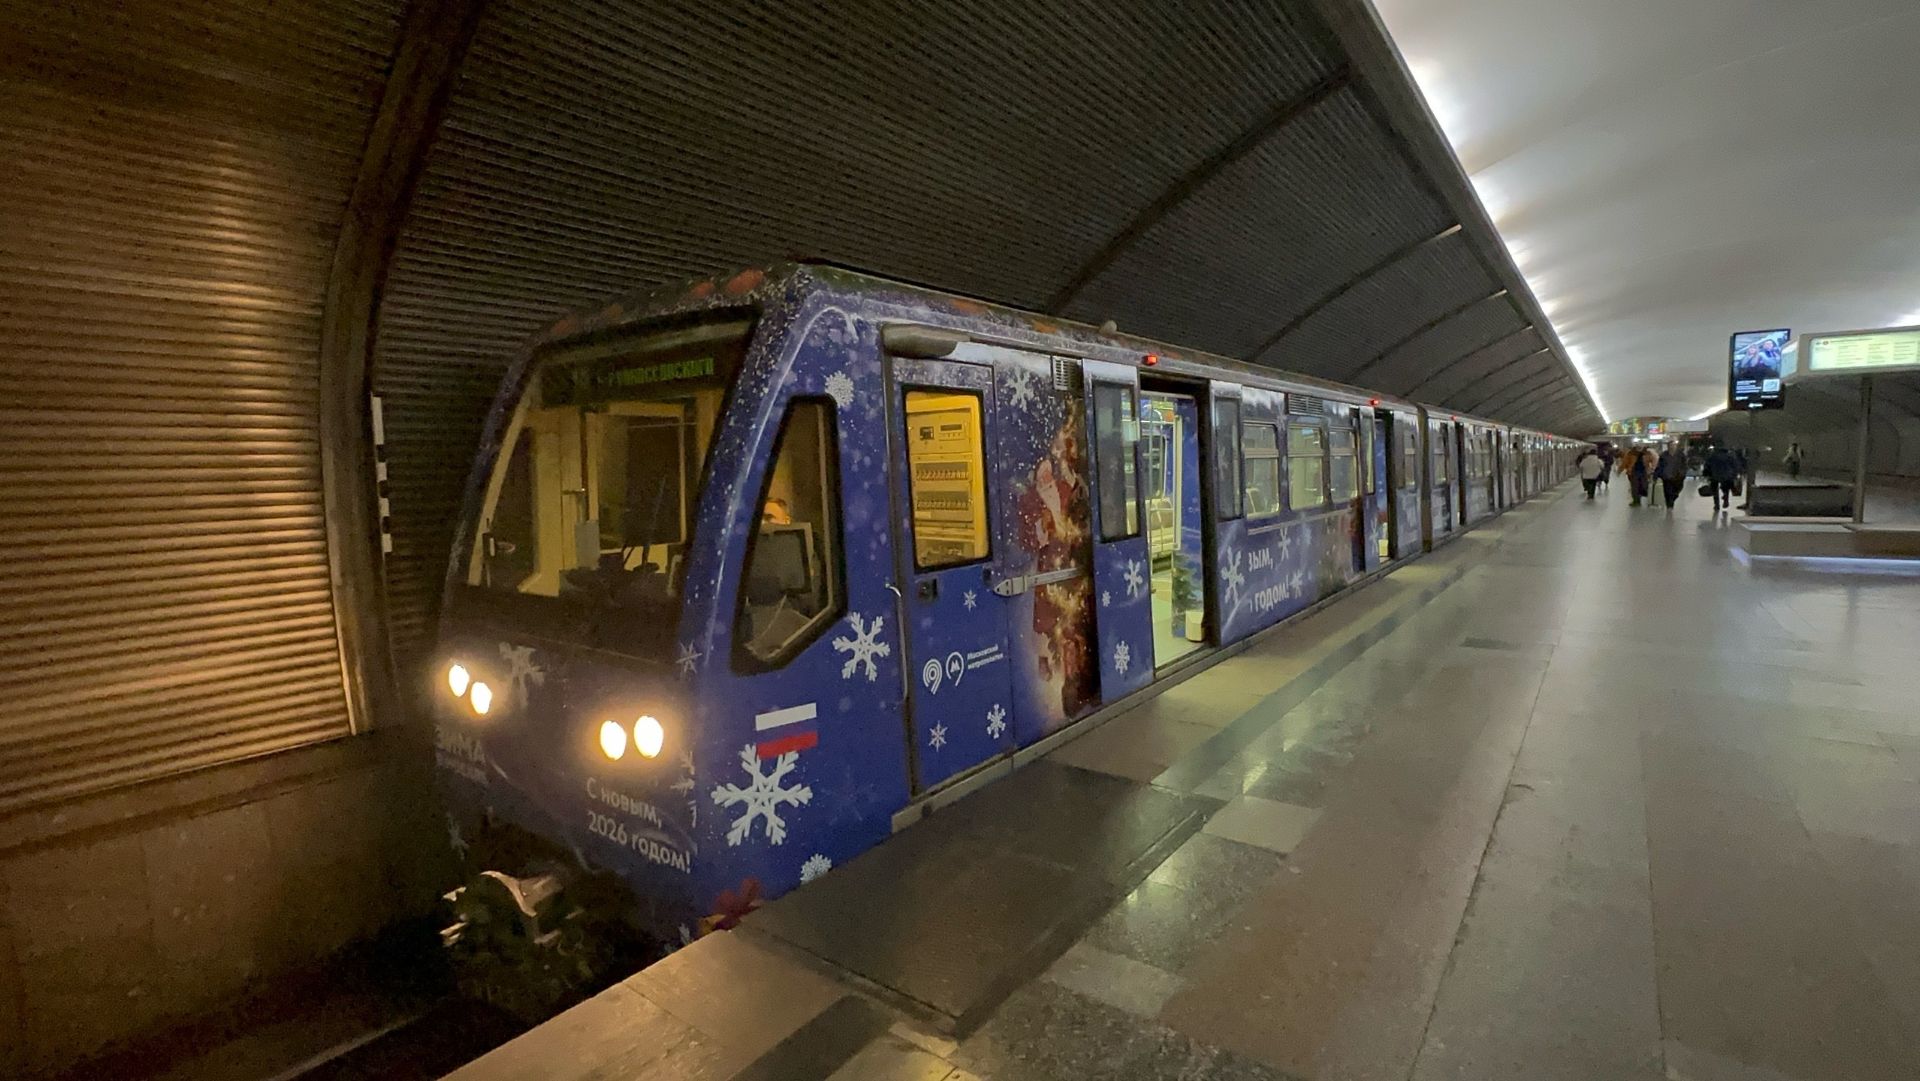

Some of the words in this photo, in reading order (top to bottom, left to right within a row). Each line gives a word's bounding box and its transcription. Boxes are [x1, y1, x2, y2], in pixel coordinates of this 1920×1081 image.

[586, 777, 598, 799] С
[587, 810, 628, 846] 2026
[631, 834, 691, 874] годом!
